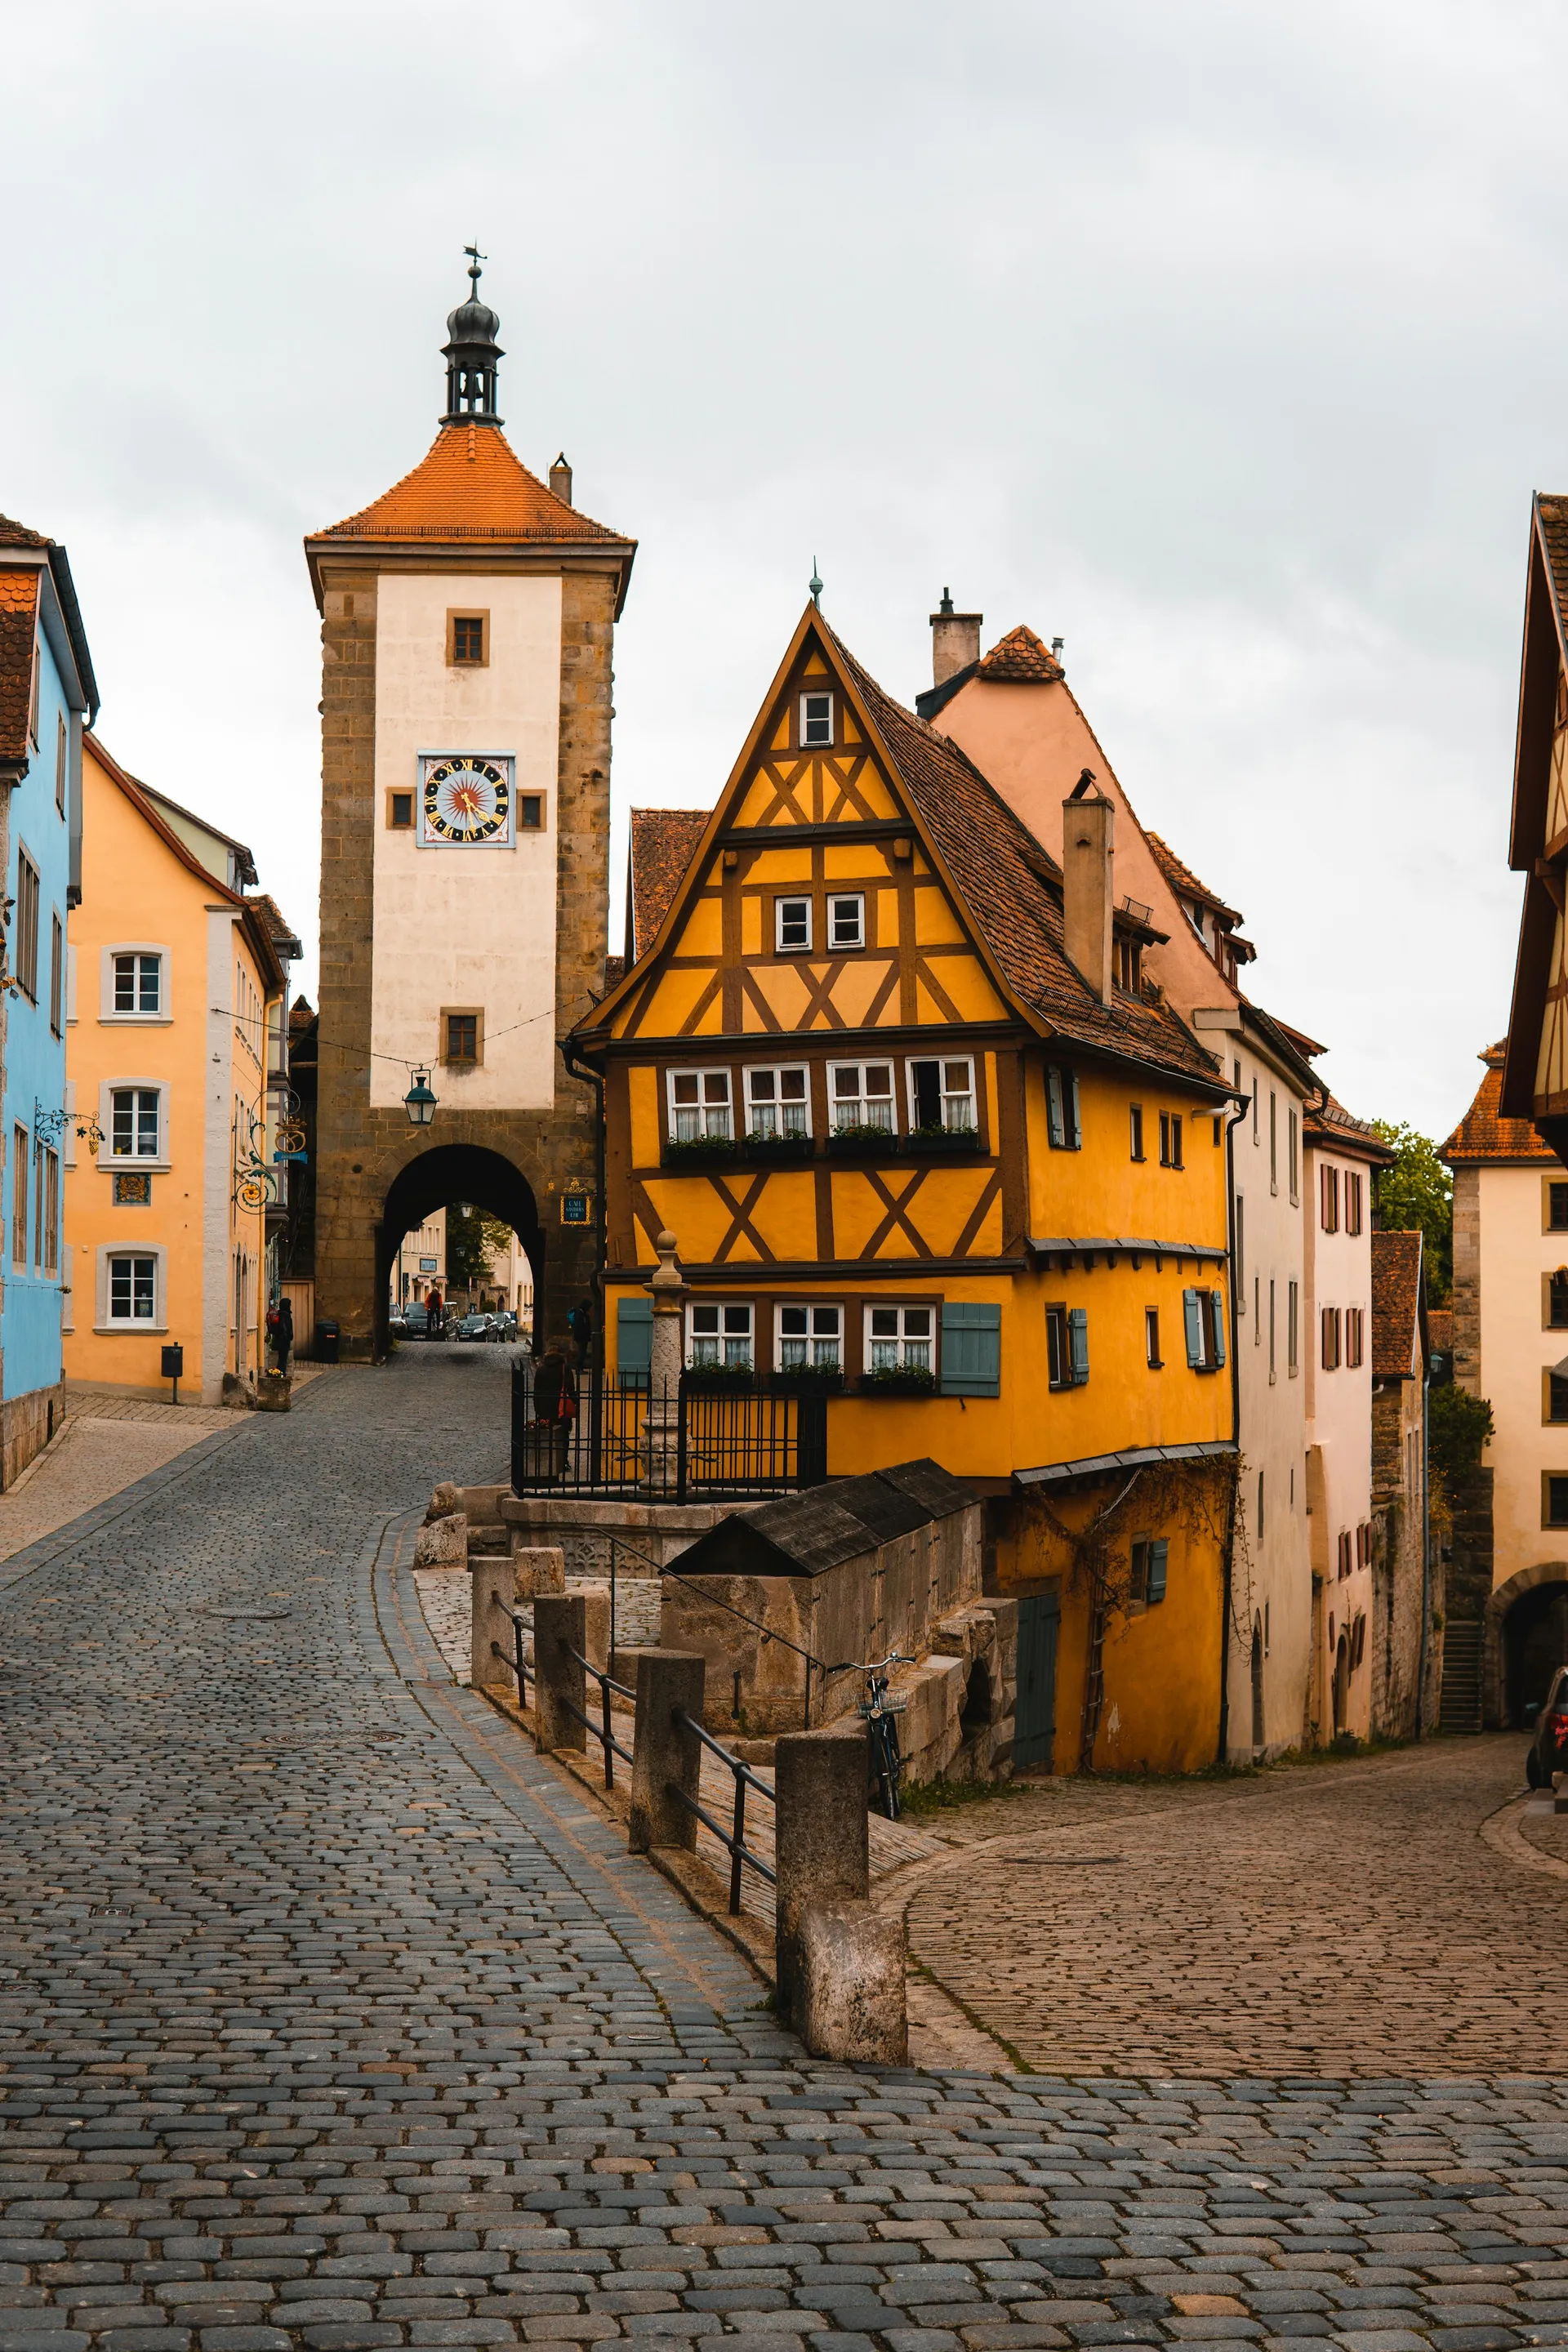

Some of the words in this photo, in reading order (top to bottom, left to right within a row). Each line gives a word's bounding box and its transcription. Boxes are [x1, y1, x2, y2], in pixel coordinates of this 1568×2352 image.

[441, 762, 456, 776] XI
[460, 760, 474, 771] XII
[481, 764, 489, 776] I
[429, 776, 443, 787] X
[492, 777, 505, 788] II
[425, 795, 437, 806] IX
[497, 795, 508, 806] III
[481, 826, 490, 838] V
